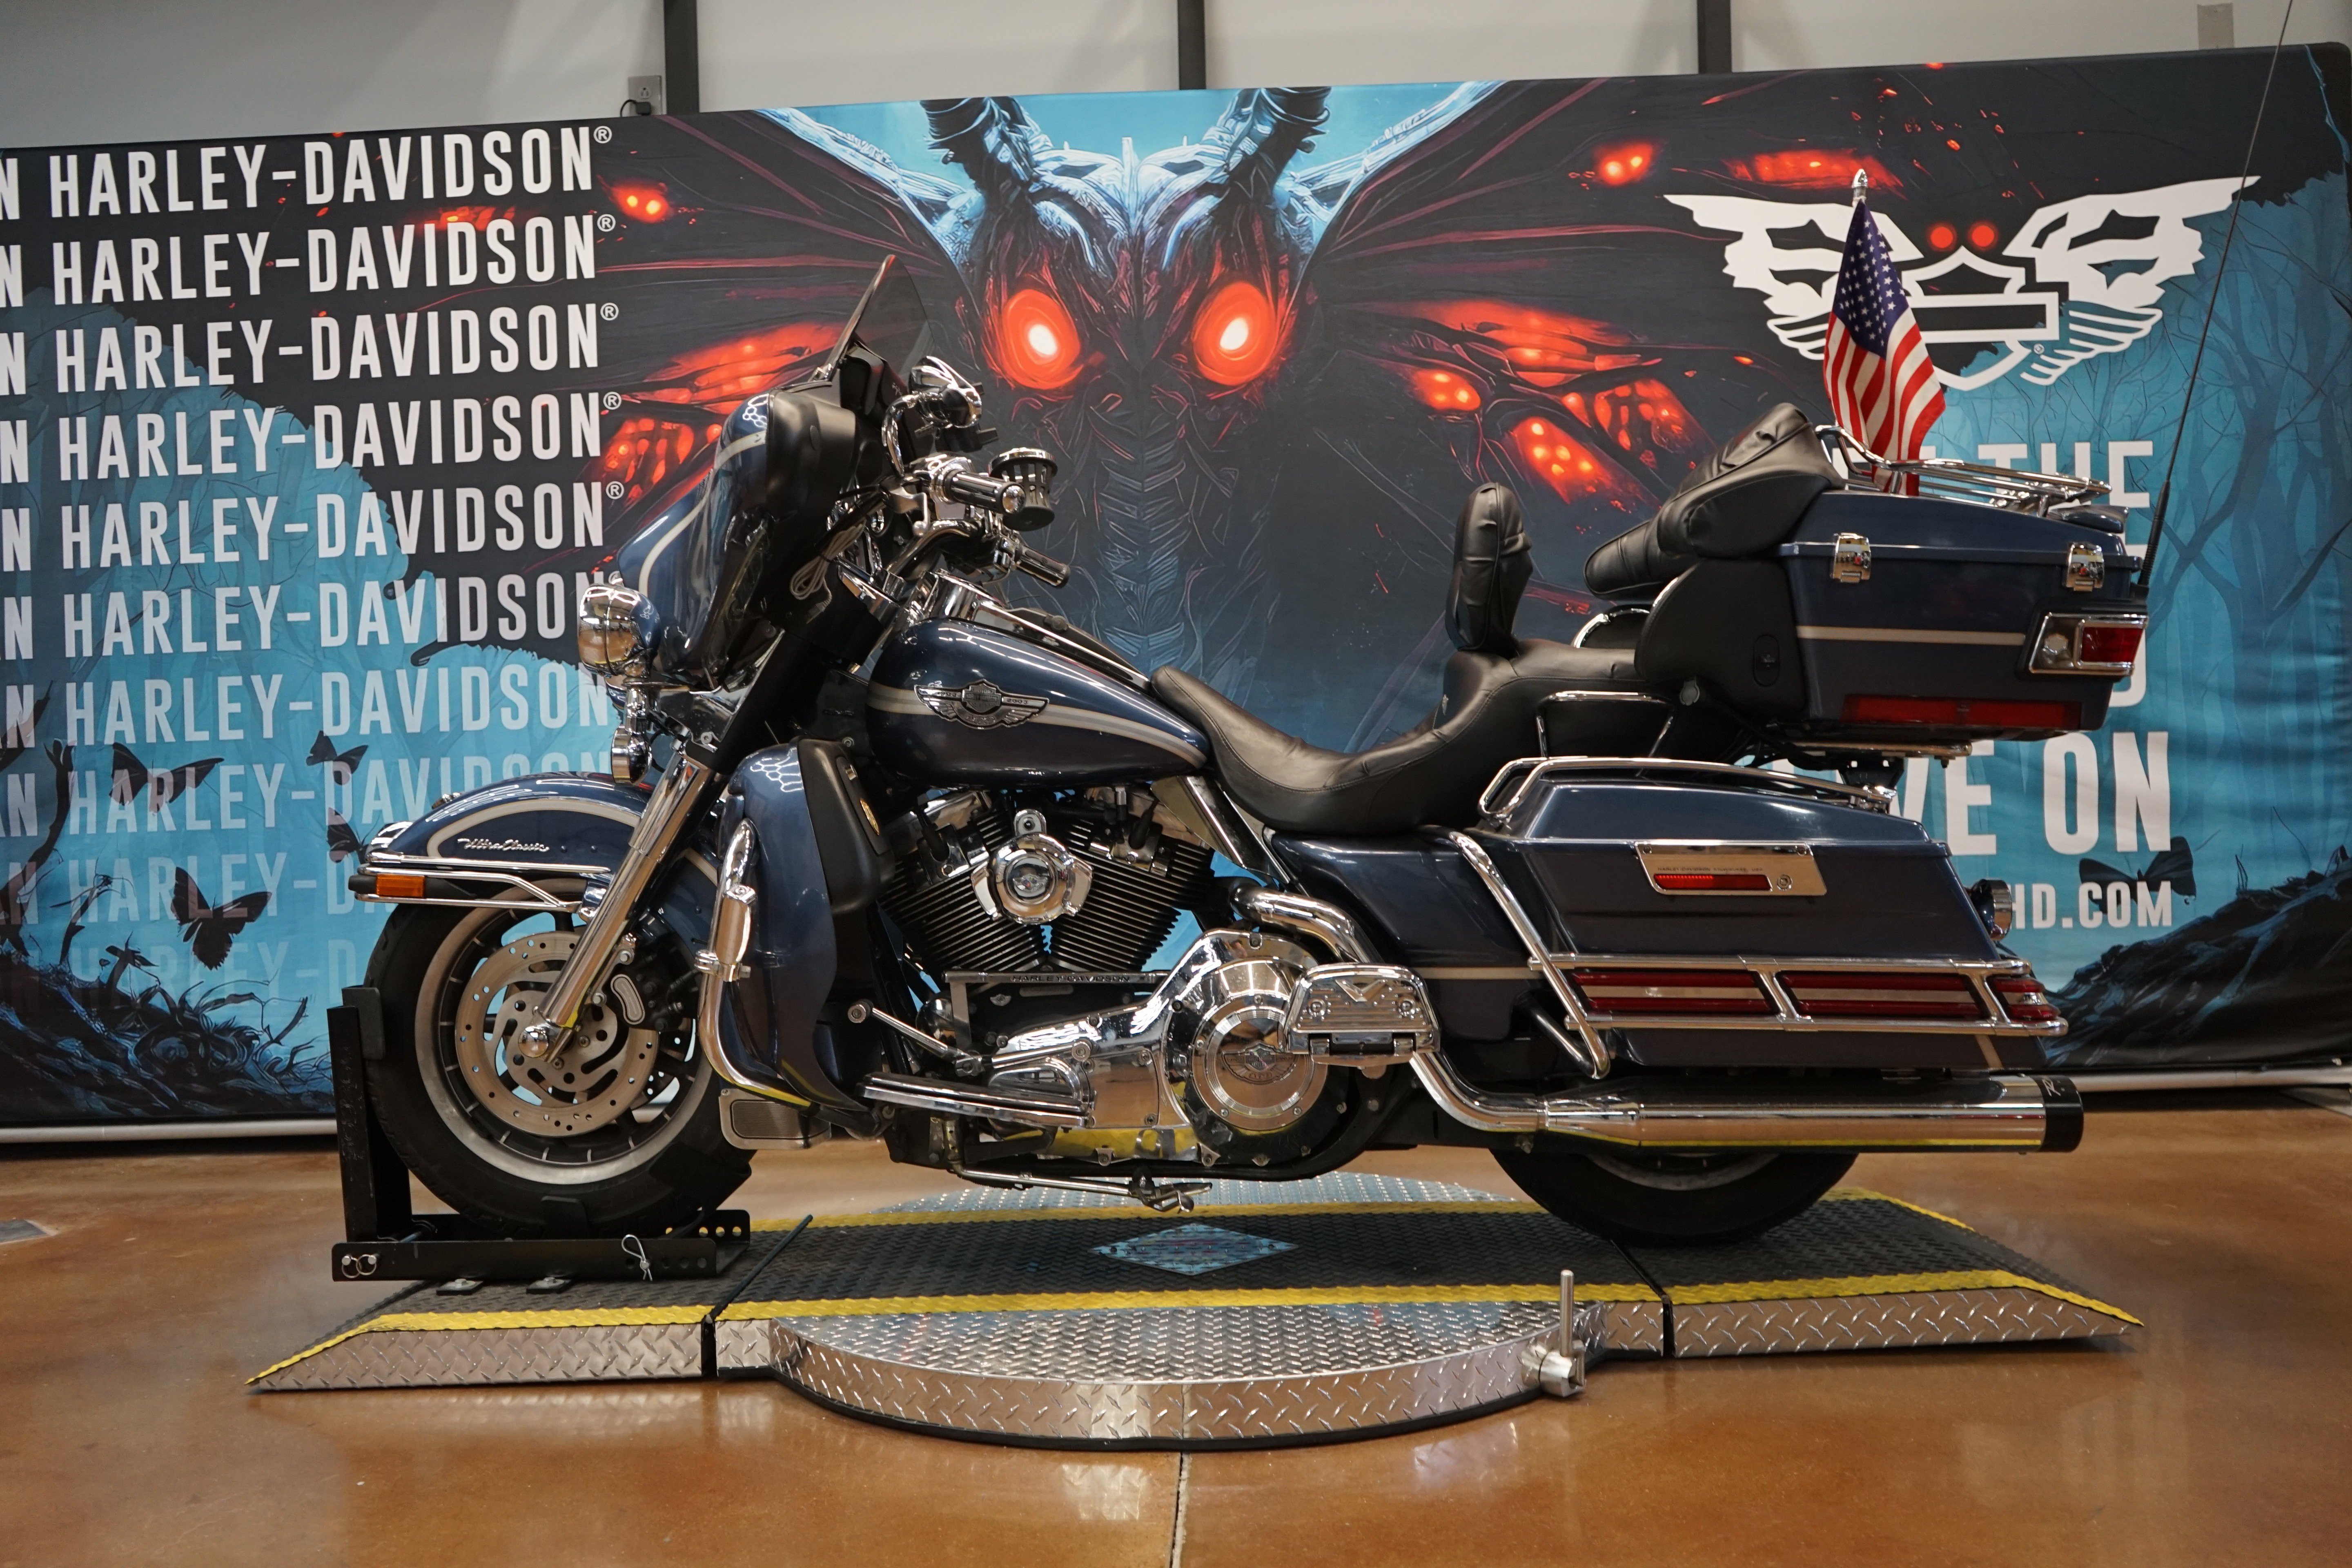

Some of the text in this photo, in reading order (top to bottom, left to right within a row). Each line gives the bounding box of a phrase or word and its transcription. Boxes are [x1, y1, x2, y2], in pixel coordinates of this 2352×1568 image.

[0, 684, 35, 748] N
[0, 773, 38, 837] N
[2044, 731, 2171, 855] ON
